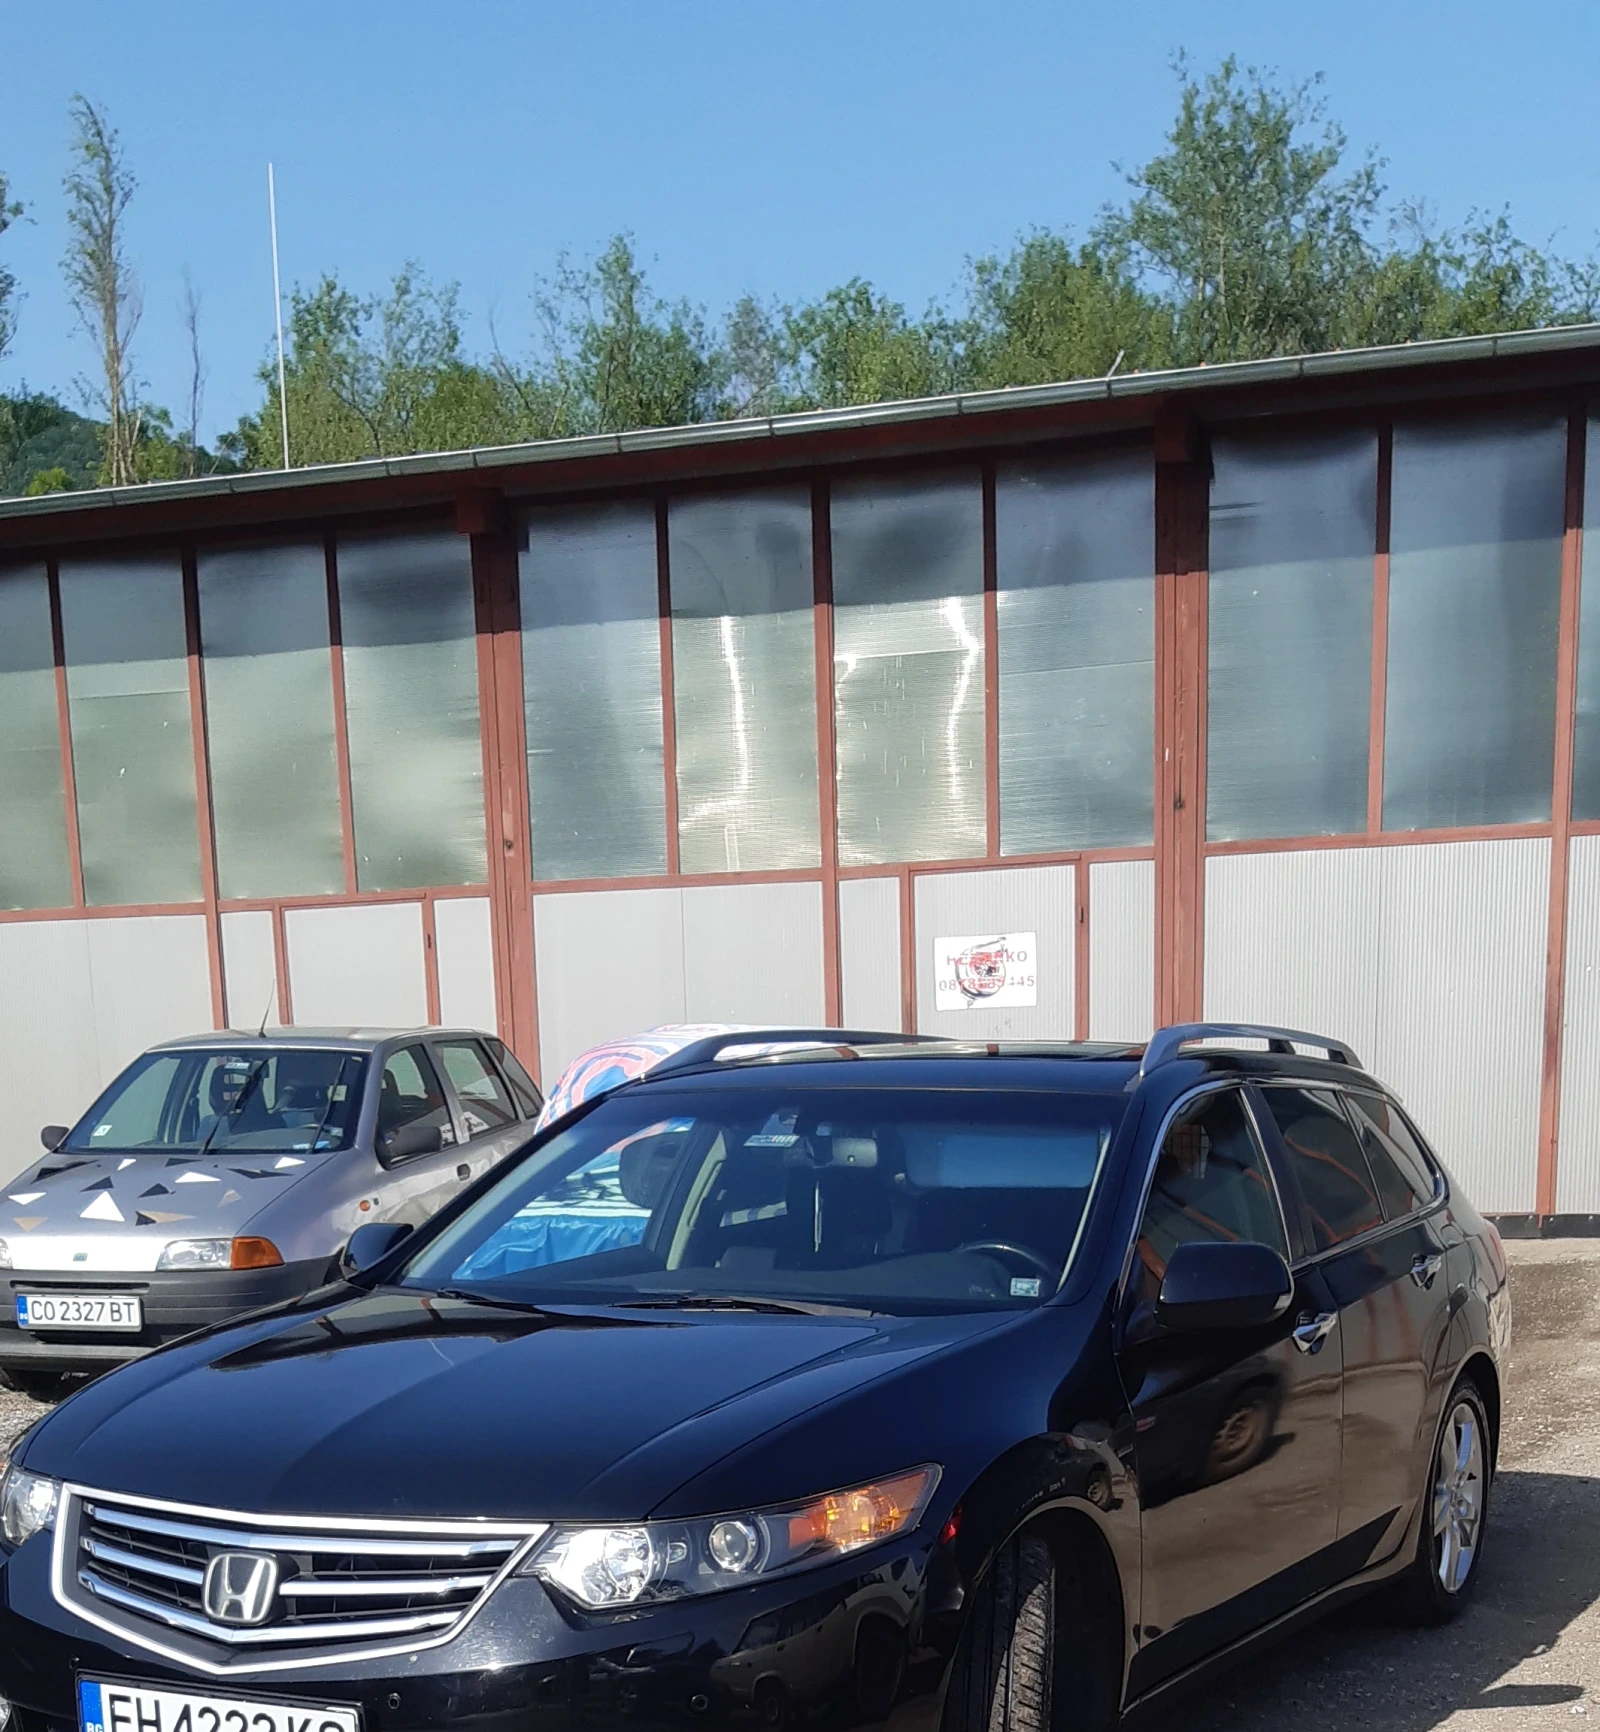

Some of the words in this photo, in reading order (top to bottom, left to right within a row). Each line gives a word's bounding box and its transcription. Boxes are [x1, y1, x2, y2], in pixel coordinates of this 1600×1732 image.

[31, 1300, 55, 1321] CO
[60, 1301, 105, 1322] 2327
[109, 1302, 135, 1322] BT
